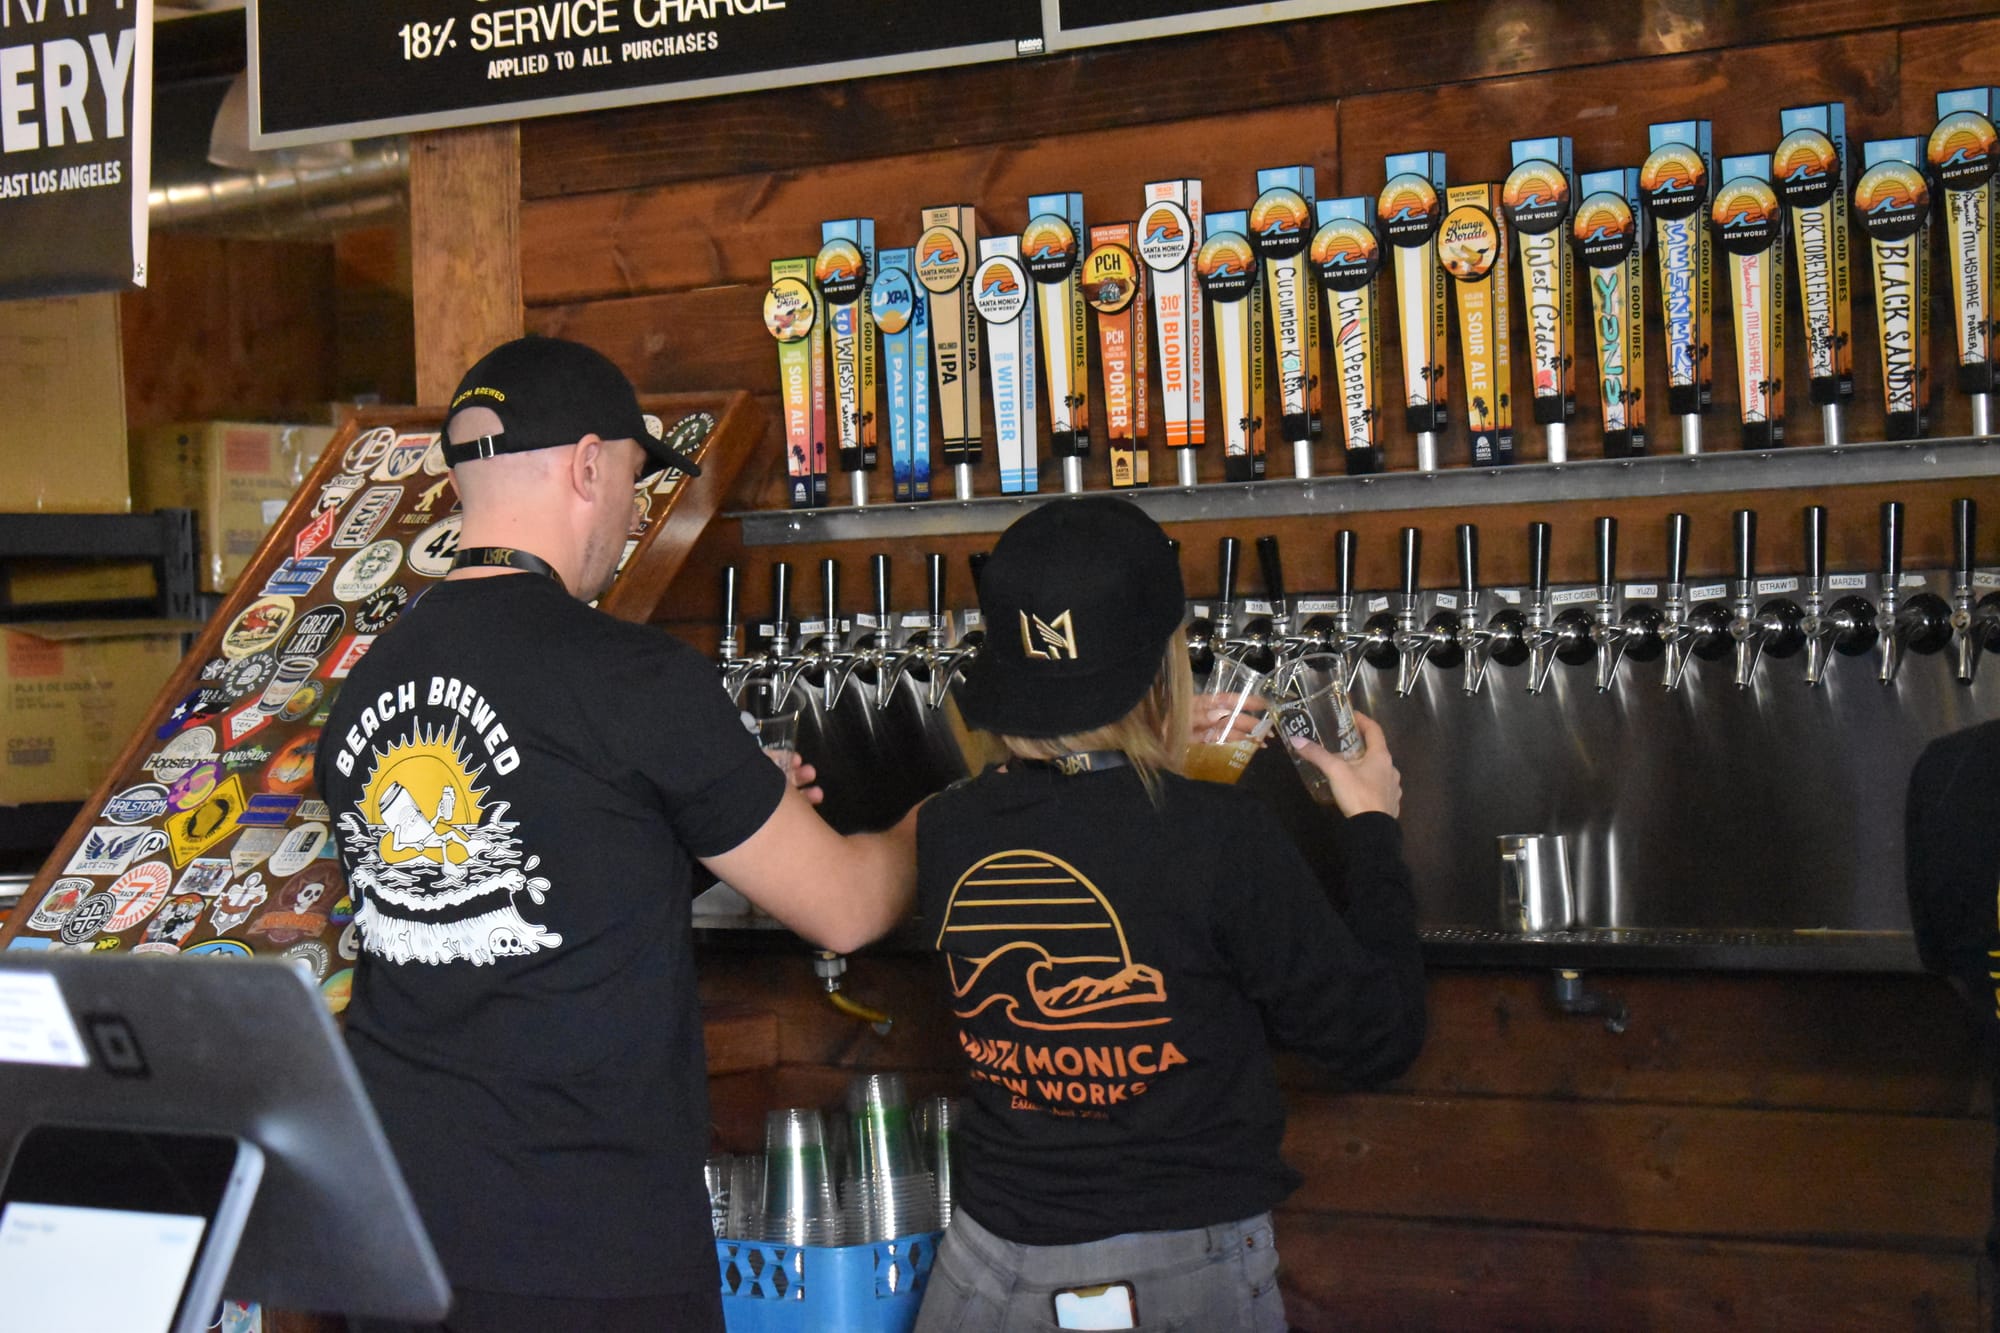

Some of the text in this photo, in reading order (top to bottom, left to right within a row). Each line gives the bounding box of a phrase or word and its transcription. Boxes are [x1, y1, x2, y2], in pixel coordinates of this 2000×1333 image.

[398, 18, 457, 61] 18%
[470, 0, 620, 52] SERVICE
[487, 31, 719, 79] APPLIED TO ALL PURCHASES
[31, 169, 57, 194] LOS
[59, 160, 122, 191] ANGELES
[1863, 171, 1916, 198] SANTA MONICA
[1942, 166, 1989, 179] BREW WORKS
[1671, 196, 1695, 204] WORKS
[1448, 219, 1484, 232] Mango
[1868, 214, 1916, 226] BREW WORKS
[1143, 246, 1161, 254] SANTA
[1445, 229, 1488, 244] Dorado
[1585, 243, 1623, 254] BREW WORKS
[1837, 226, 1846, 261] GOOD
[1095, 254, 1121, 273] PCH
[1344, 268, 1367, 276] WORKS
[1524, 237, 1558, 295] West
[1702, 240, 1710, 274] GOOD
[1800, 212, 1830, 314] OKTOBERFEST
[979, 298, 1020, 308] SANTA MONICA
[1631, 286, 1640, 320] GOOD
[1774, 274, 1783, 308] GOOD
[1075, 301, 1084, 331] GOOD
[1498, 308, 1508, 340] SOUR
[1876, 244, 1915, 406] BLACK SANDS
[864, 322, 873, 352] GOOD
[1106, 330, 1124, 345] PCH
[1136, 293, 1144, 373] CHOCOLATE
[1192, 320, 1200, 374] BLONDE
[1253, 321, 1262, 353] GOOD
[1467, 311, 1485, 356] SOUR
[941, 353, 957, 385] IPA
[968, 348, 976, 371] IPA
[1164, 321, 1181, 393] BLONDE
[1500, 343, 1508, 367] ALE
[788, 366, 803, 405] SOUR
[893, 357, 904, 408] PALE
[1024, 354, 1034, 410] WITBIER
[1471, 361, 1487, 390] ALE
[474, 387, 505, 402] BREWED
[815, 391, 824, 410] ALE
[916, 371, 926, 414] PALE
[997, 366, 1015, 441] WITBIER
[1109, 359, 1128, 429] PORTER
[1192, 380, 1200, 404] ALE
[791, 409, 805, 436] ALE
[896, 414, 906, 452] ALE
[917, 420, 927, 452] ALE
[1553, 589, 1597, 602] WEST CIDER
[1692, 587, 1726, 598] SELTZER
[1831, 577, 1864, 587] MARZEN
[1438, 596, 1453, 605] PCH
[298, 614, 341, 634] GREAT
[284, 634, 328, 654] LAKES
[336, 676, 521, 778] BEACH BREWED
[105, 799, 167, 814] HAILSTORM
[76, 862, 118, 871] GATE CITY
[115, 882, 155, 915] 7
[1024, 1042, 1189, 1078] MONICA
[1036, 1079, 1148, 1105] WORKS
